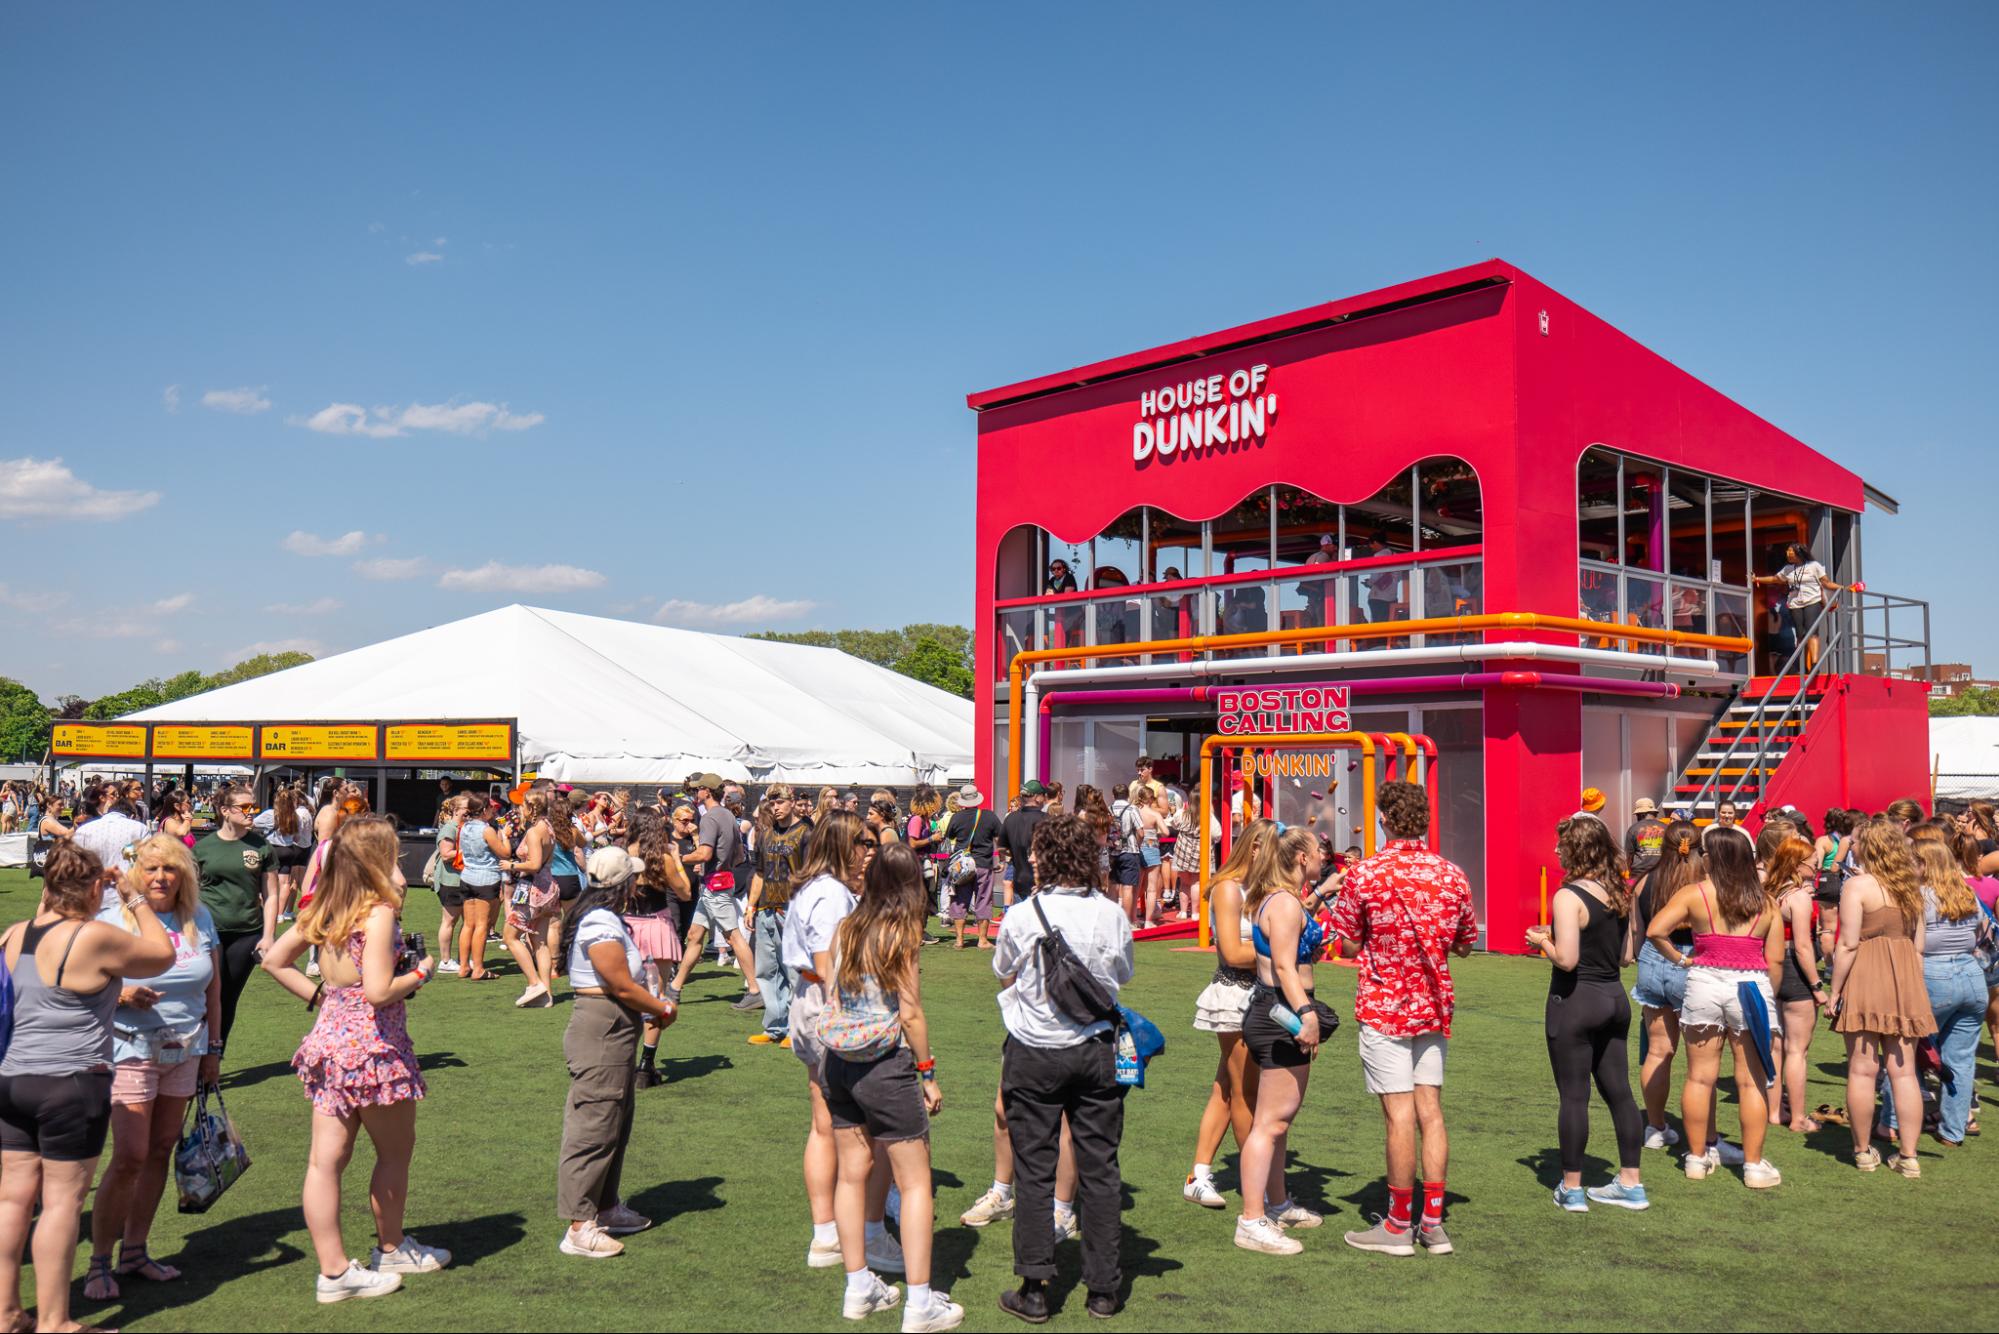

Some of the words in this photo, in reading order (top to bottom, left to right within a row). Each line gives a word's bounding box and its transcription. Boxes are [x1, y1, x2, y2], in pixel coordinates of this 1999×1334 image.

[1141, 375, 1223, 417] HOUSE
[1229, 364, 1269, 397] OF
[1133, 394, 1276, 461] DUNKIN'
[1218, 687, 1350, 713] BOSTON
[1218, 711, 1350, 735] CALLING
[265, 743, 286, 751] BAR
[1241, 753, 1337, 777] DUNKIN'
